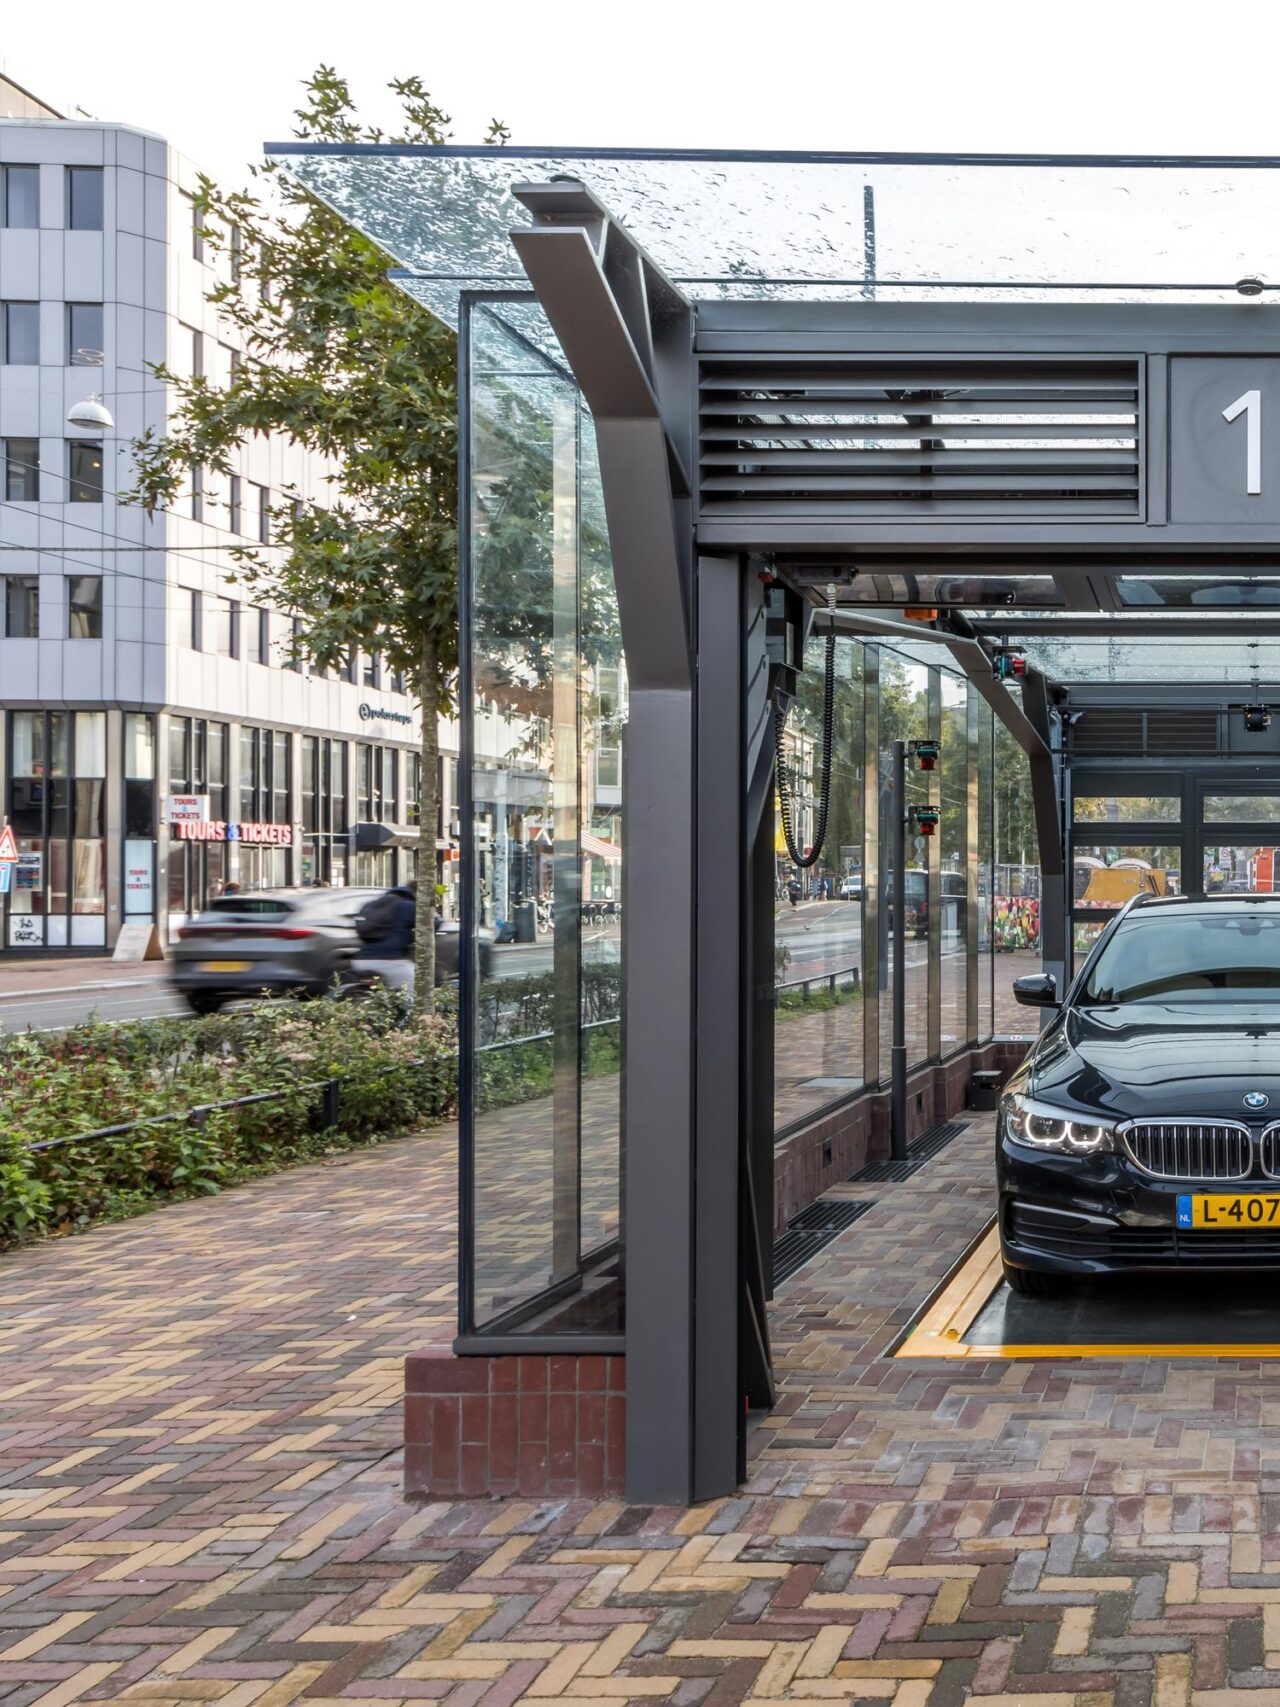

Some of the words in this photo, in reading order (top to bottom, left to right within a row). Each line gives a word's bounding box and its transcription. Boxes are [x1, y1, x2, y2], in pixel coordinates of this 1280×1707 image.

[1222, 390, 1262, 495] 1
[174, 798, 198, 806] TOURS
[171, 812, 200, 820] TICKETS
[178, 821, 226, 840] TOURS
[227, 822, 241, 841] &
[240, 823, 292, 843] TICKETS
[1179, 1214, 1191, 1222] NL
